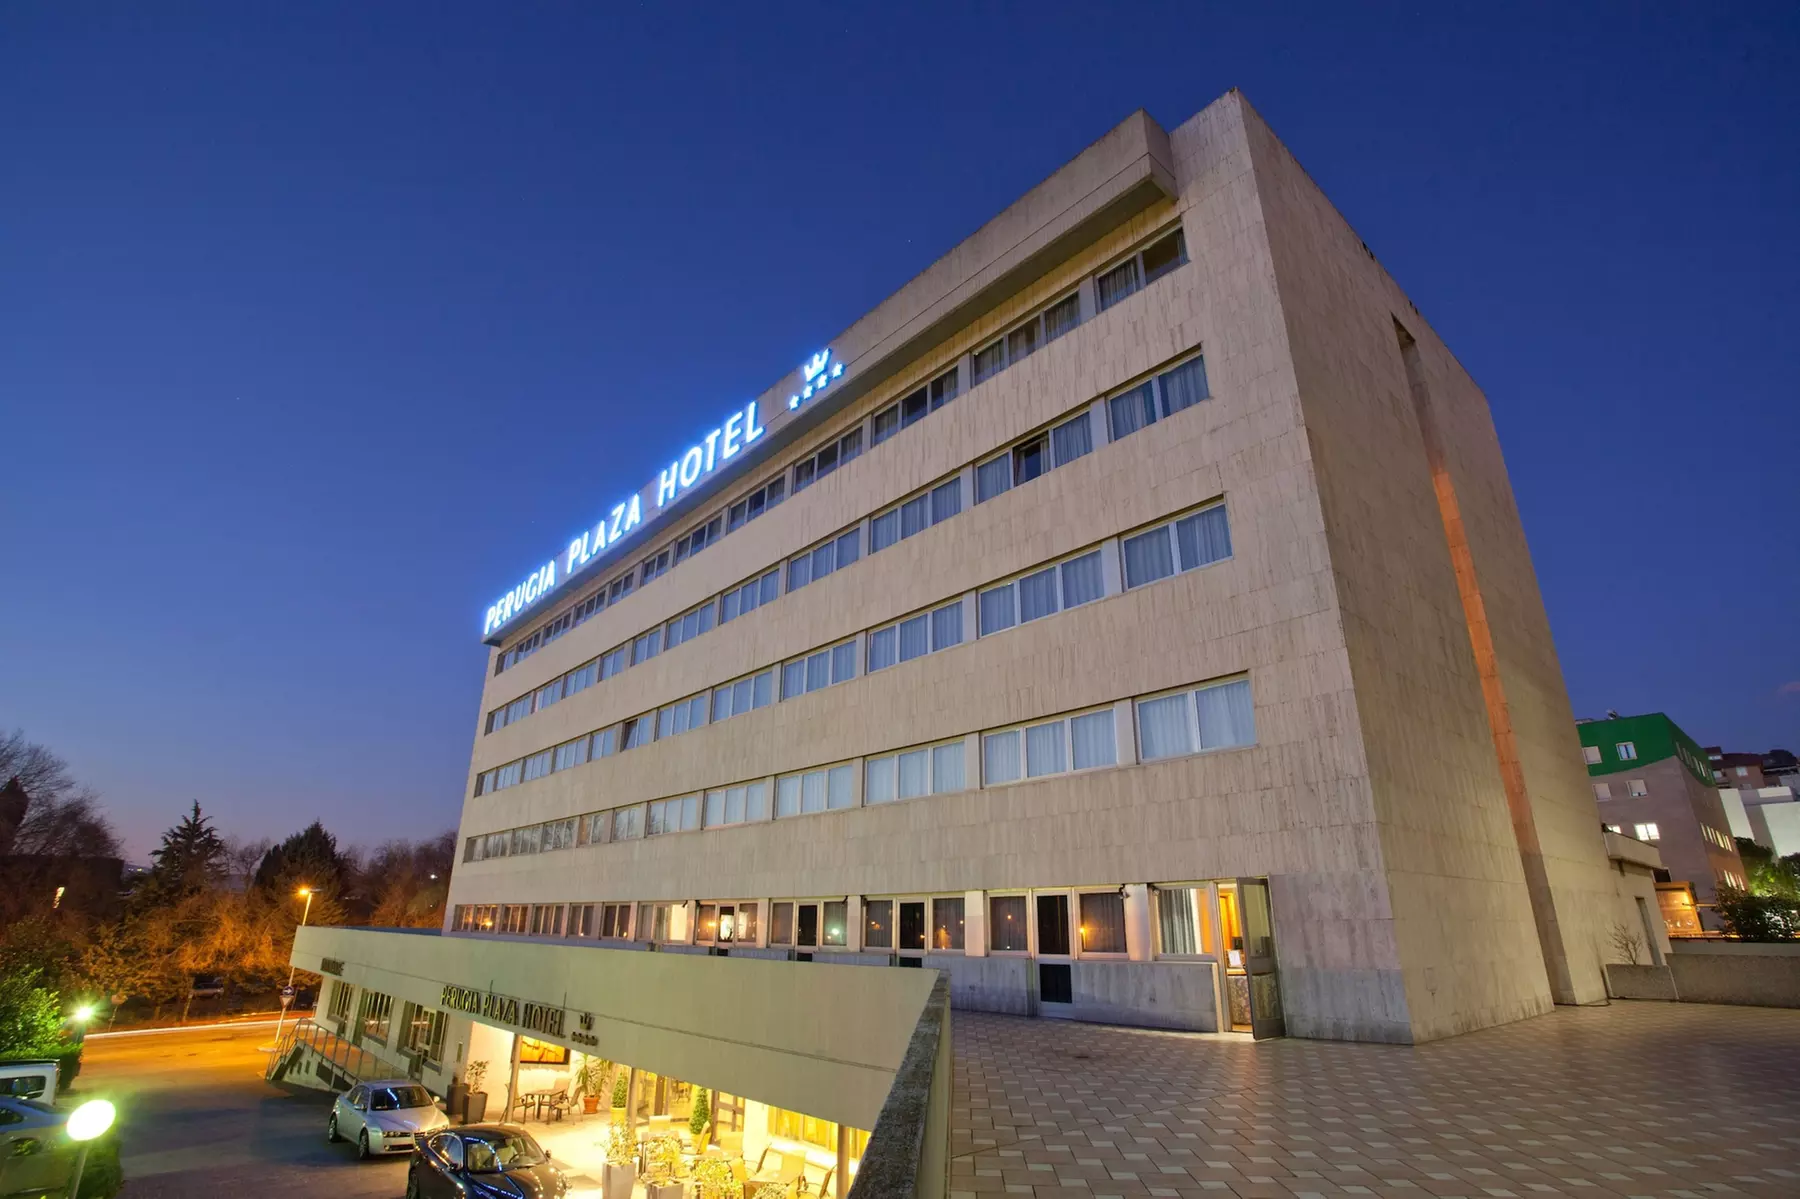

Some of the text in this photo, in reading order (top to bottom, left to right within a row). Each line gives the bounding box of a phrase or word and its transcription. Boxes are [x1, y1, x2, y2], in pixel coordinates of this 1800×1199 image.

[483, 401, 765, 635] PERUGIA PLAZA HOTEL
[440, 985, 566, 1039] PERUGIA PLAZA HOTEL
